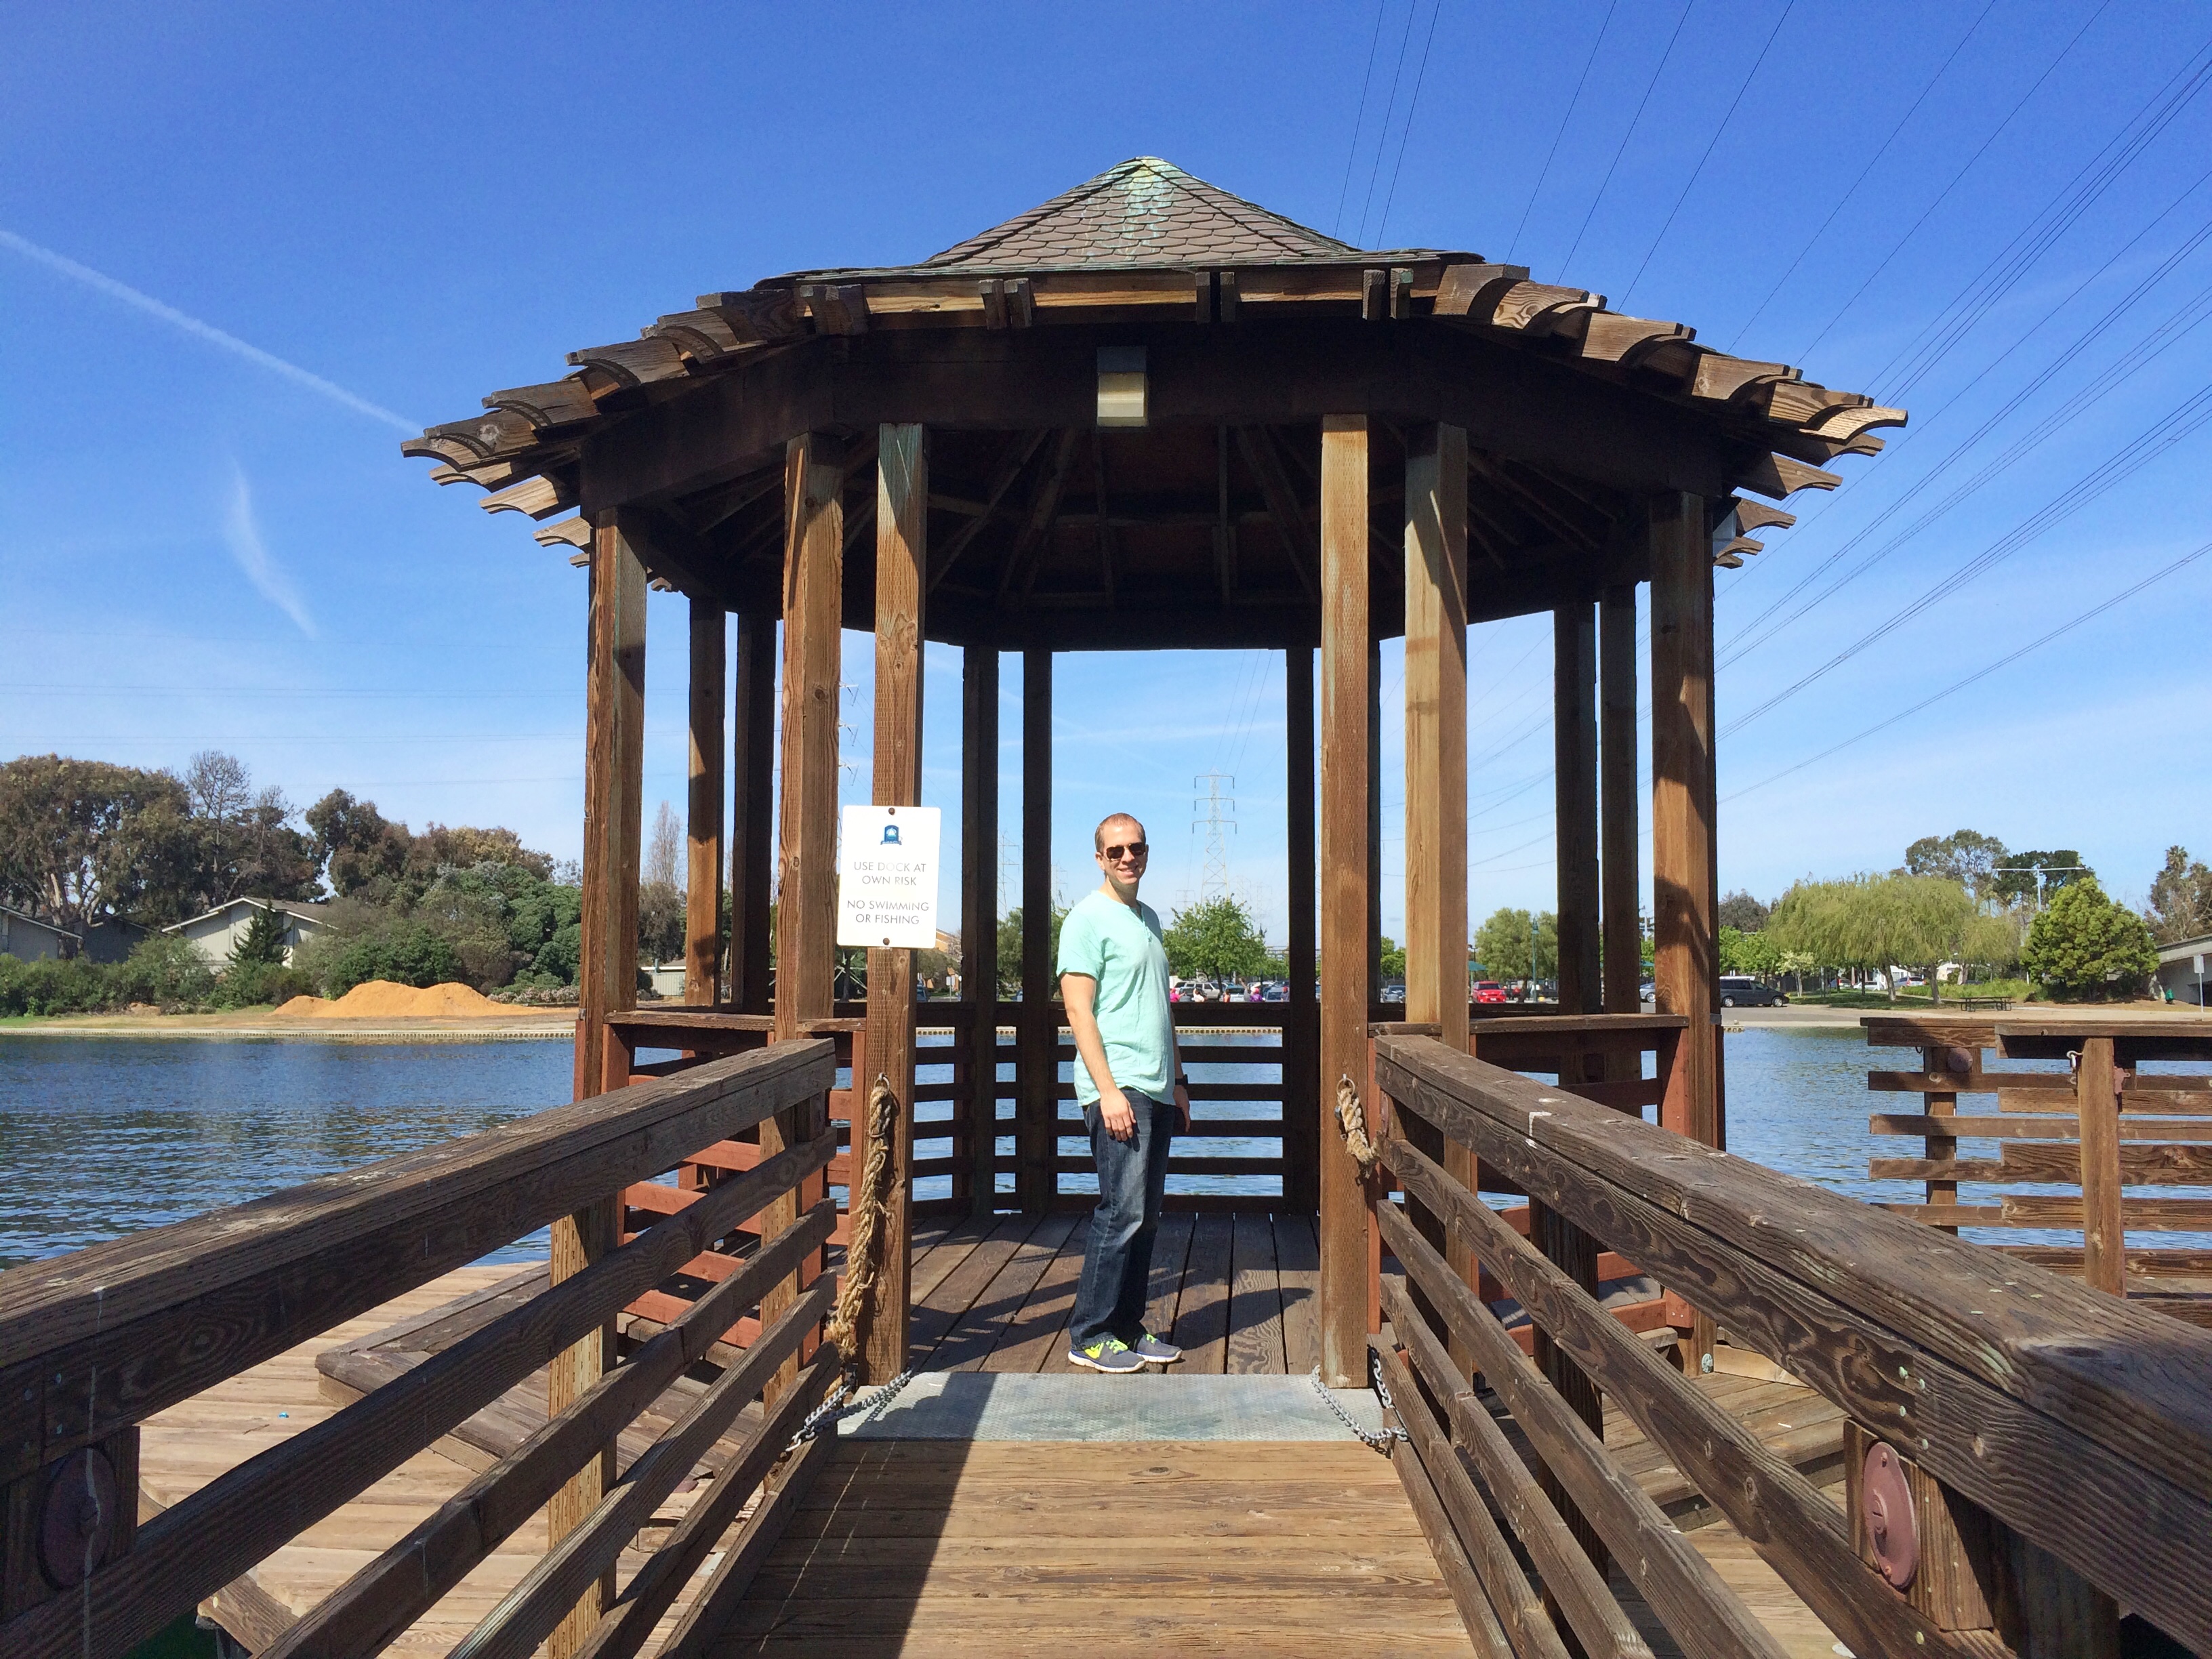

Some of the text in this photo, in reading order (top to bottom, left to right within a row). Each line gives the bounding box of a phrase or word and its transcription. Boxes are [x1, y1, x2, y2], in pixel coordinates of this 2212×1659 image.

[854, 861, 926, 872] USE DOCK AT
[862, 875, 917, 886] OWN RISK
[847, 900, 929, 911] NO SWIMMING
[855, 914, 920, 924] OR FISHING
